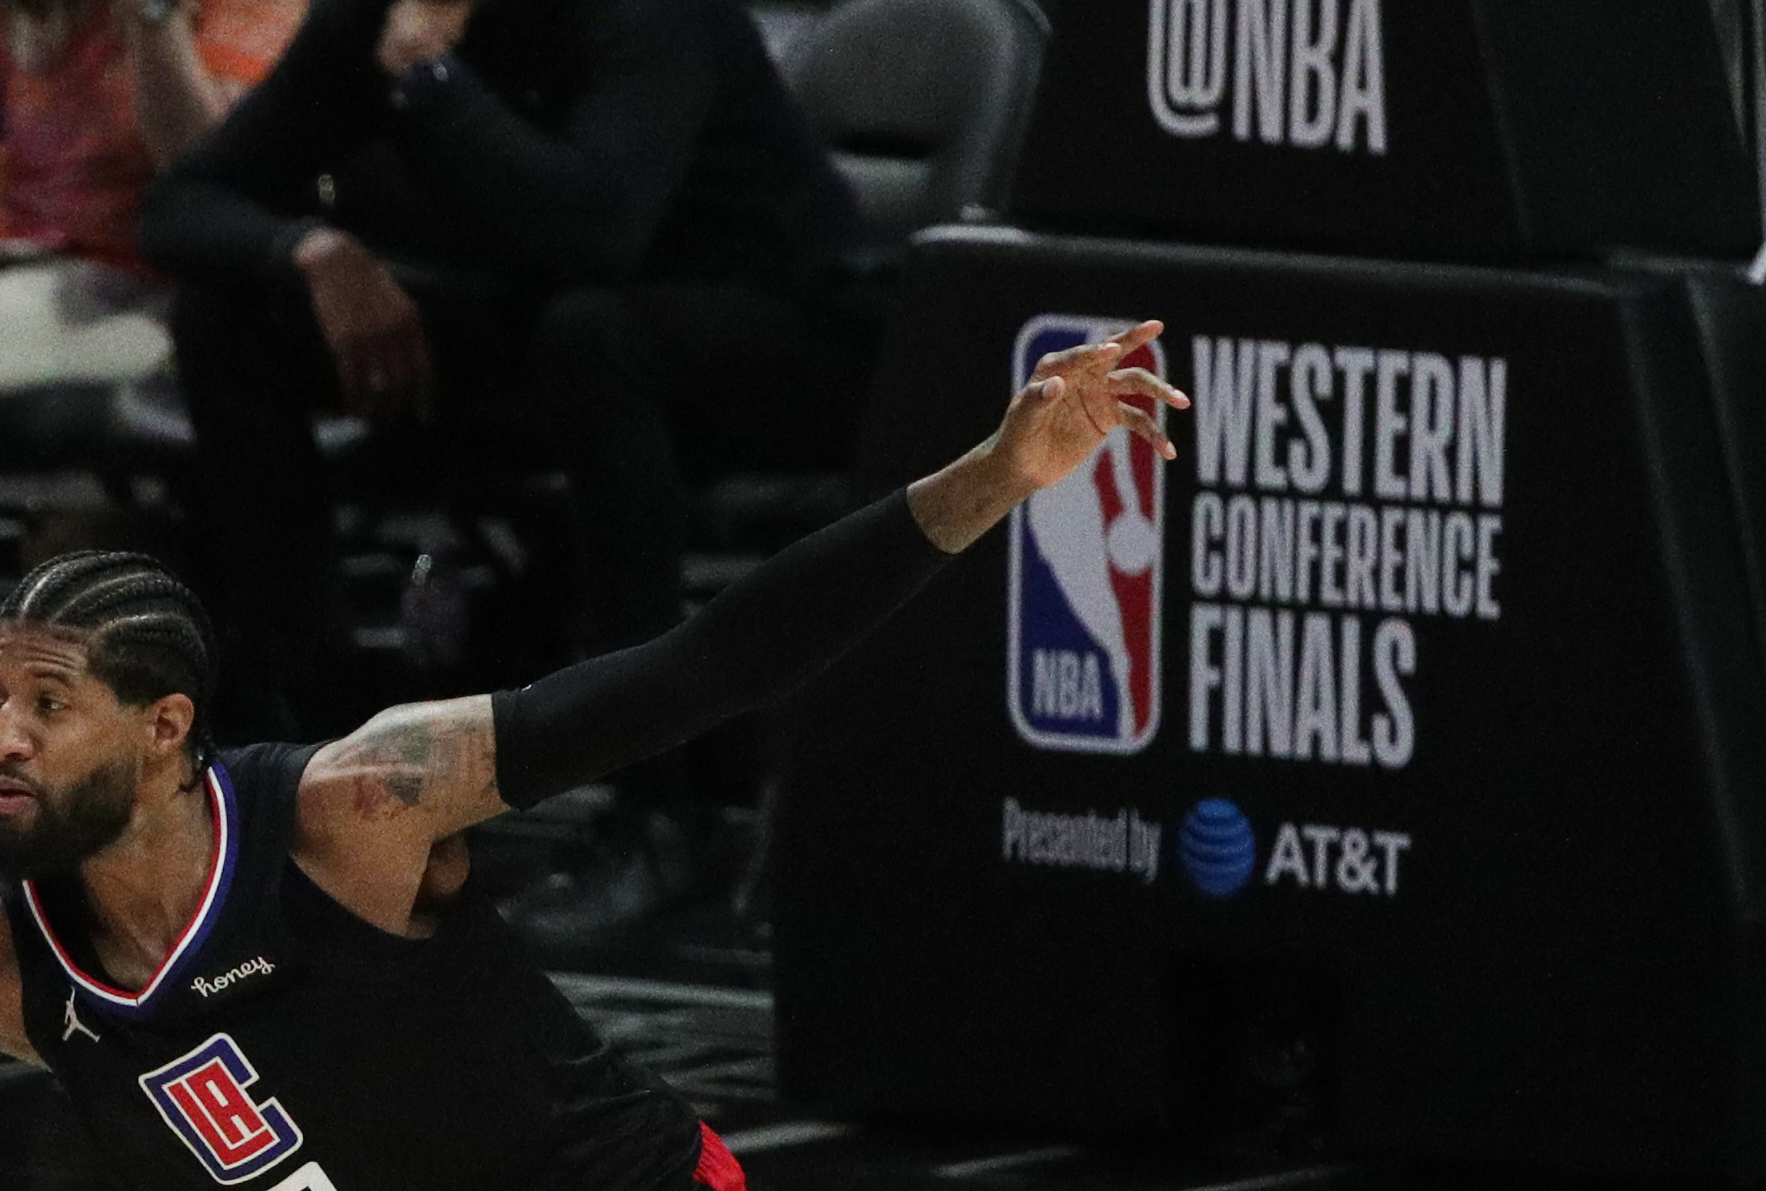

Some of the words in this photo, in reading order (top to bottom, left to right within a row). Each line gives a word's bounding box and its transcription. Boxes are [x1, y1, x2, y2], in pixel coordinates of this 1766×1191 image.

[1147, 0, 1387, 156] @NBA
[1191, 336, 1507, 506] WESTERN
[1190, 492, 1502, 620] CONFERENCE
[1033, 648, 1103, 722] NBA
[1188, 601, 1417, 769] FINALS
[1002, 796, 1127, 872] Presented
[1130, 806, 1162, 885] by
[1265, 822, 1411, 894] AT&T
[191, 956, 275, 997] honey
